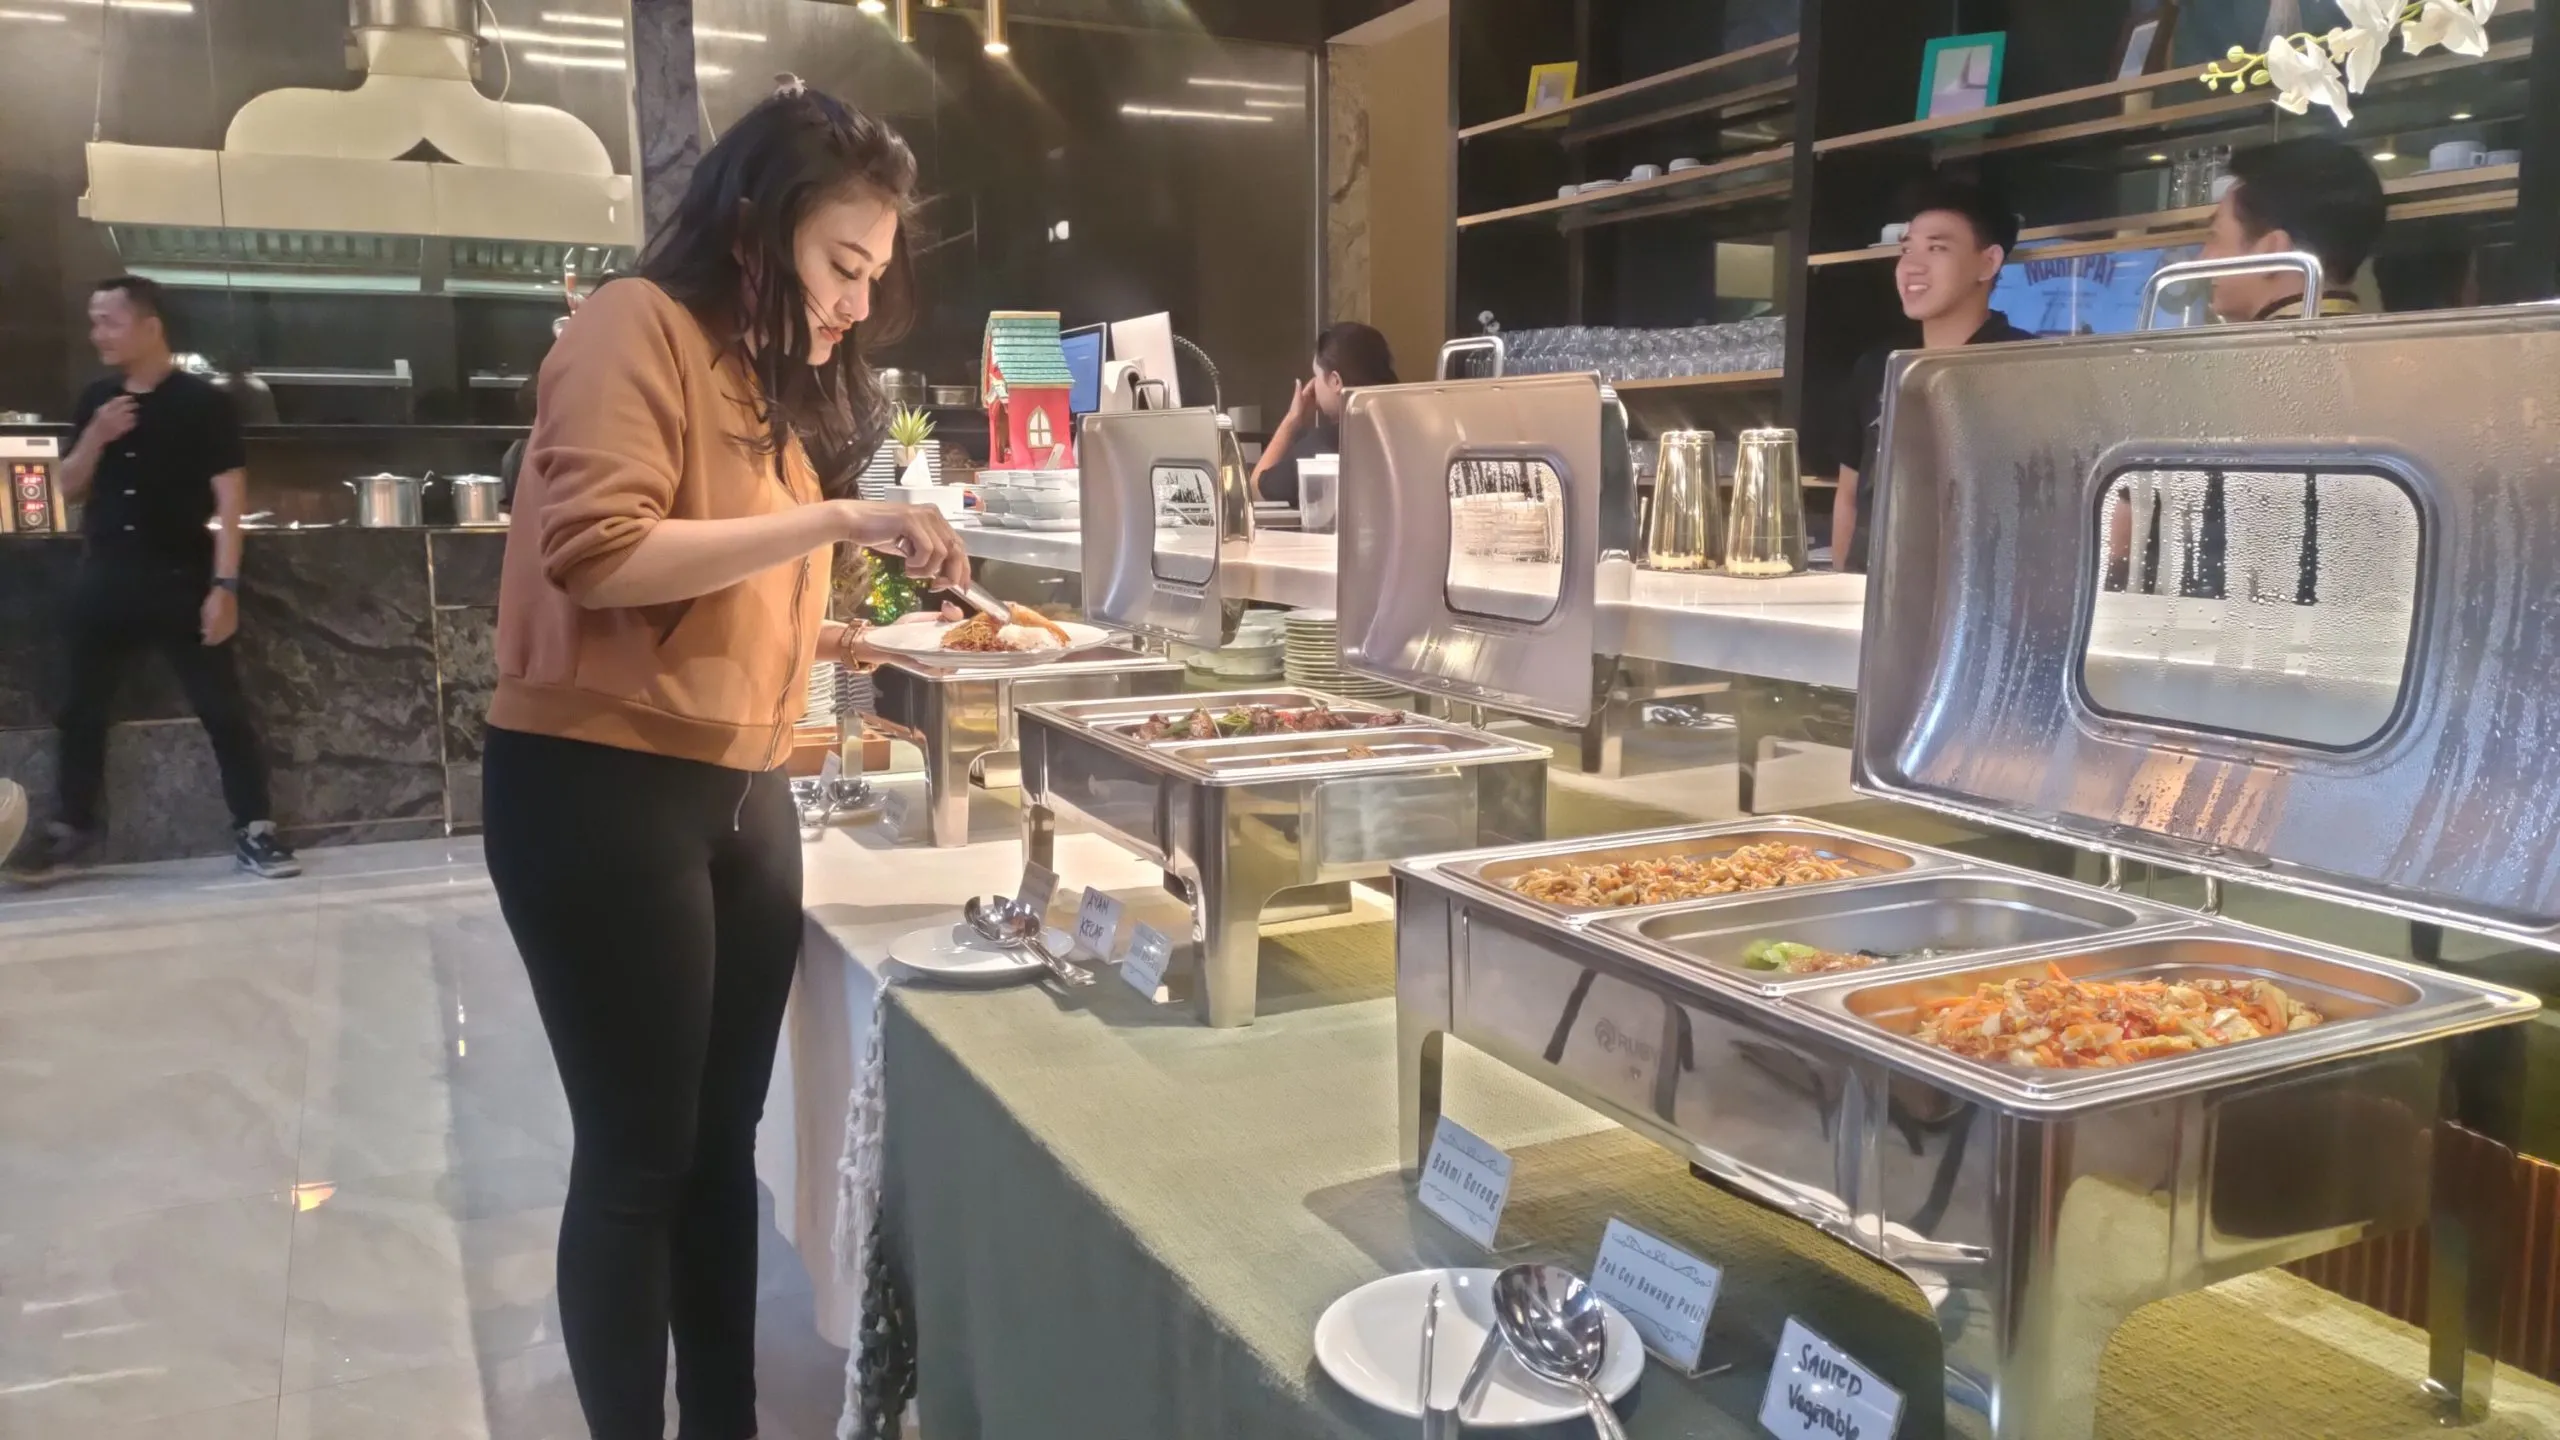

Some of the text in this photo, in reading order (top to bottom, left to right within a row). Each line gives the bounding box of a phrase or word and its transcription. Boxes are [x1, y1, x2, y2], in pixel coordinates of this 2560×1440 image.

[1431, 1152, 1501, 1212] Bakmi Goreng
[1637, 1276, 1676, 1311] Bawang
